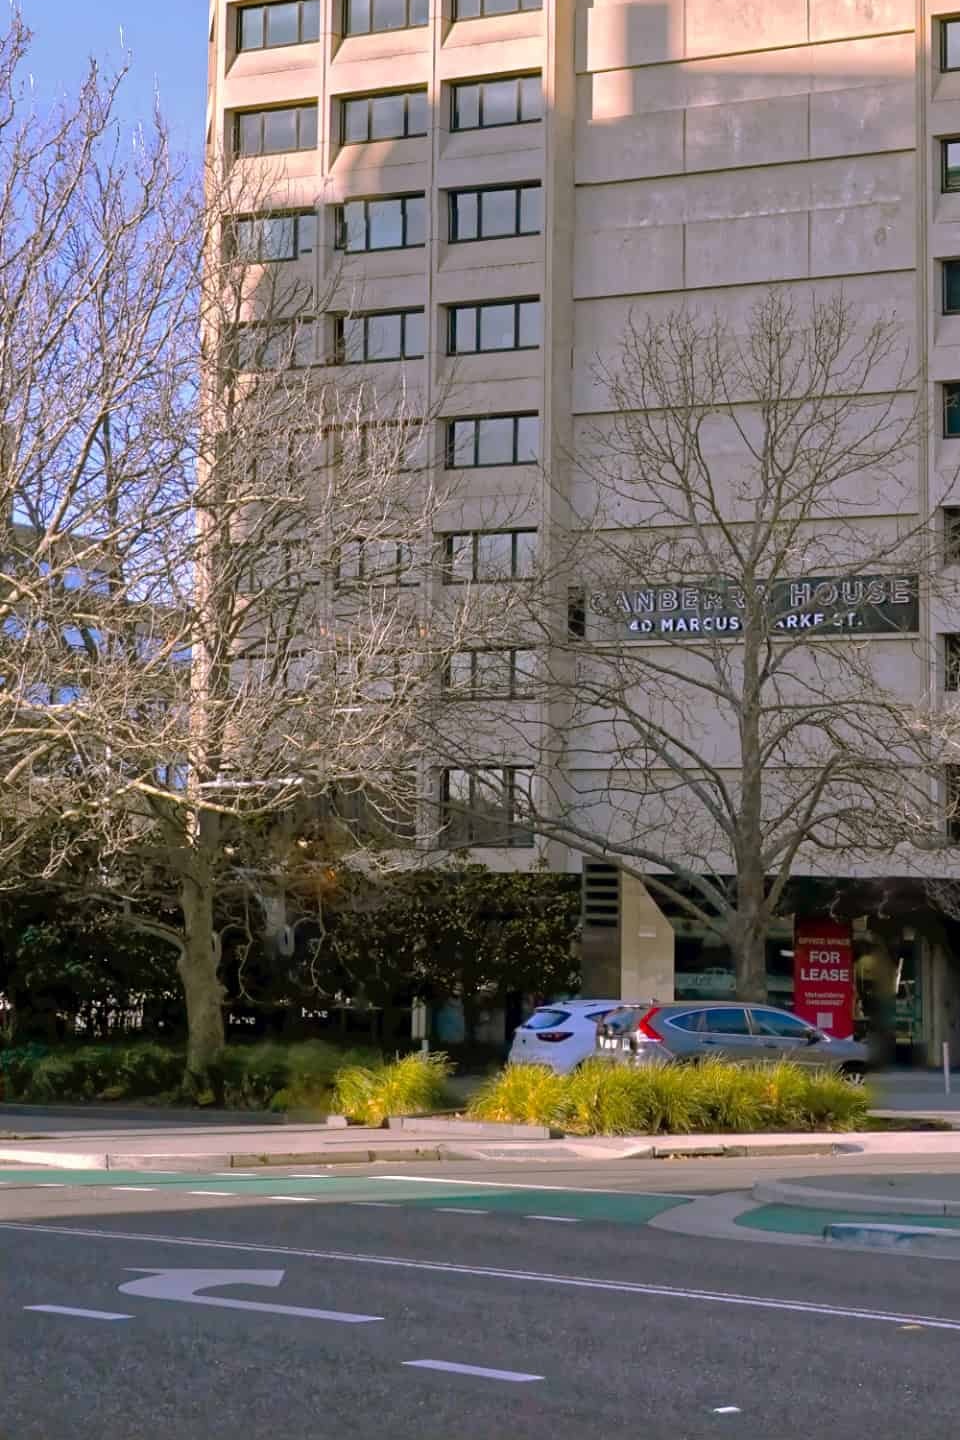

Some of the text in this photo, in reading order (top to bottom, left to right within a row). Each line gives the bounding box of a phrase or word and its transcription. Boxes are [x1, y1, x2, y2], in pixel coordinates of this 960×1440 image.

[790, 580, 910, 607] HOUSE
[661, 616, 739, 632] MARCUS
[809, 951, 841, 964] FOR
[800, 967, 849, 982] LEASE
